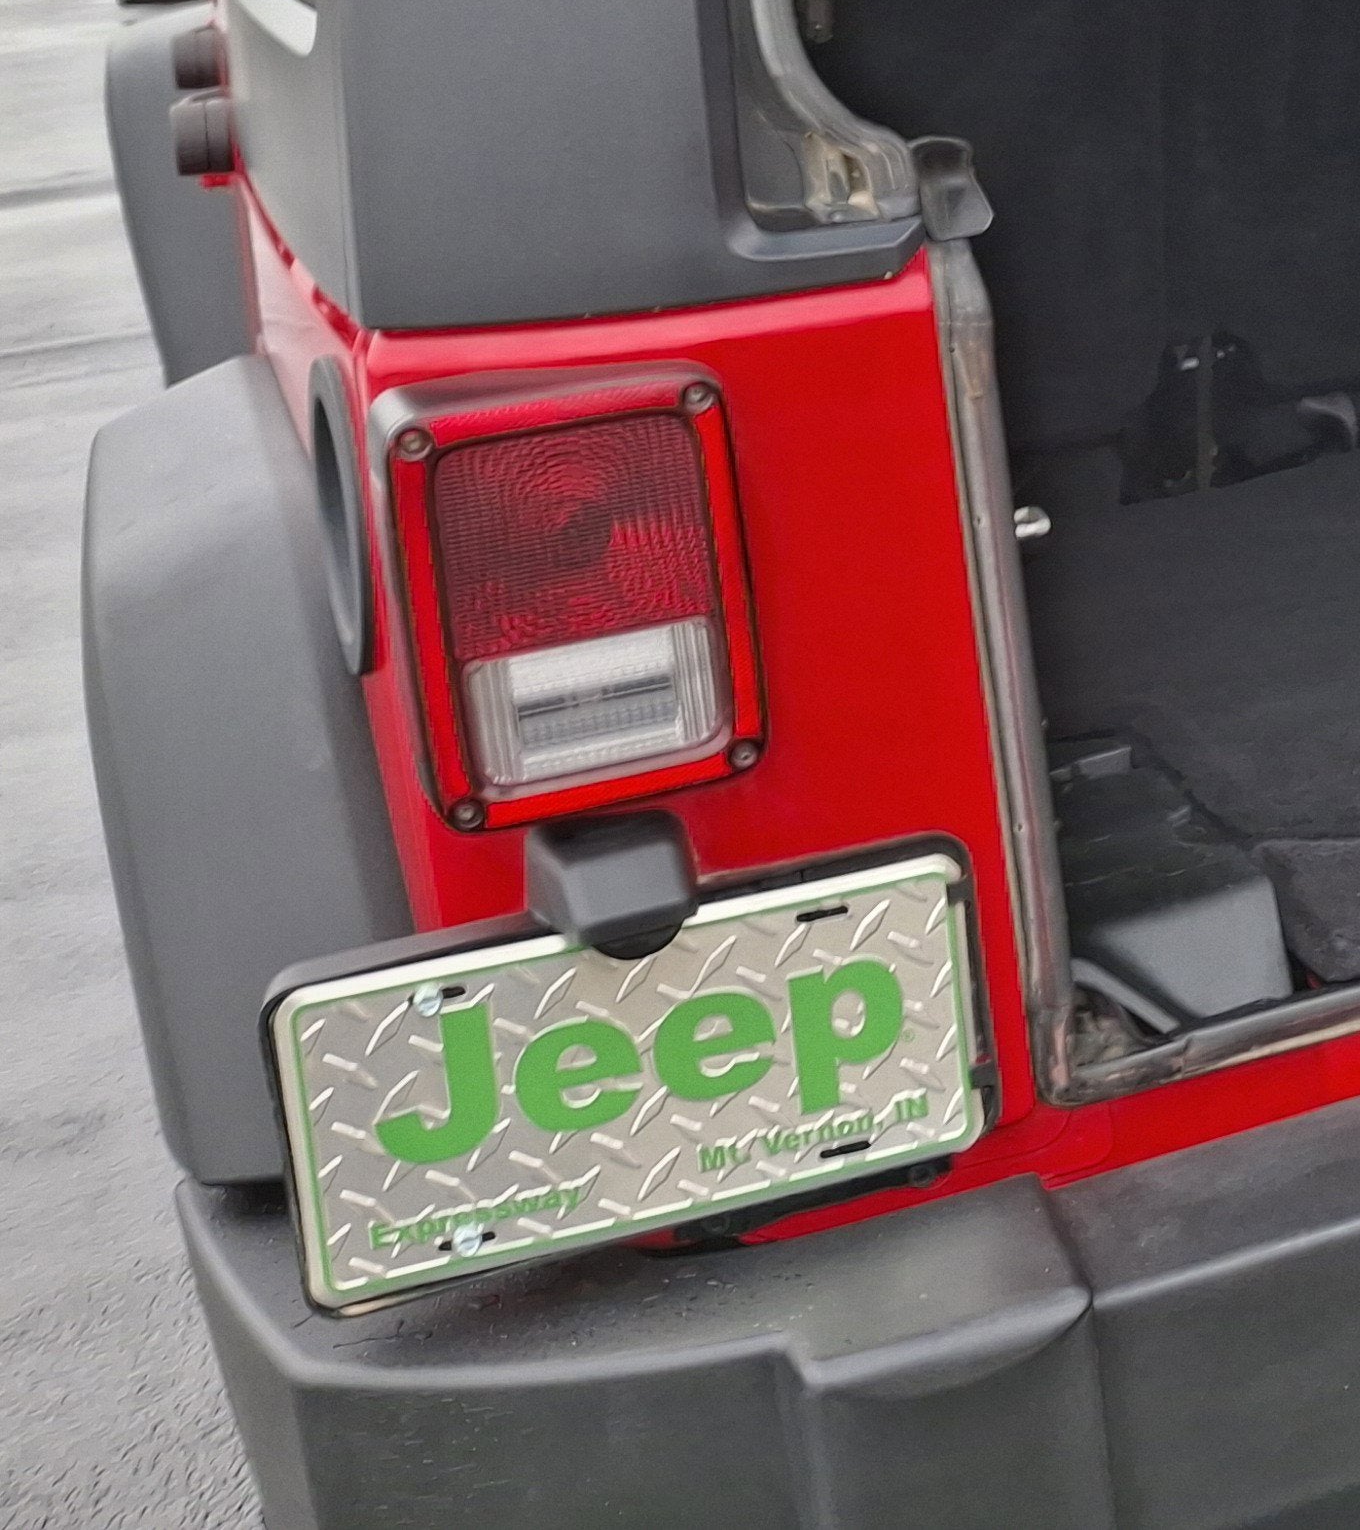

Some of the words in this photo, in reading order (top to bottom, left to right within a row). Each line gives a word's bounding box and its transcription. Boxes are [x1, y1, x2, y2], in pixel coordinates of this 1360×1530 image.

[374, 958, 904, 1165] Jeep
[894, 1092, 930, 1123] IN
[368, 1184, 581, 1251] Expressway
